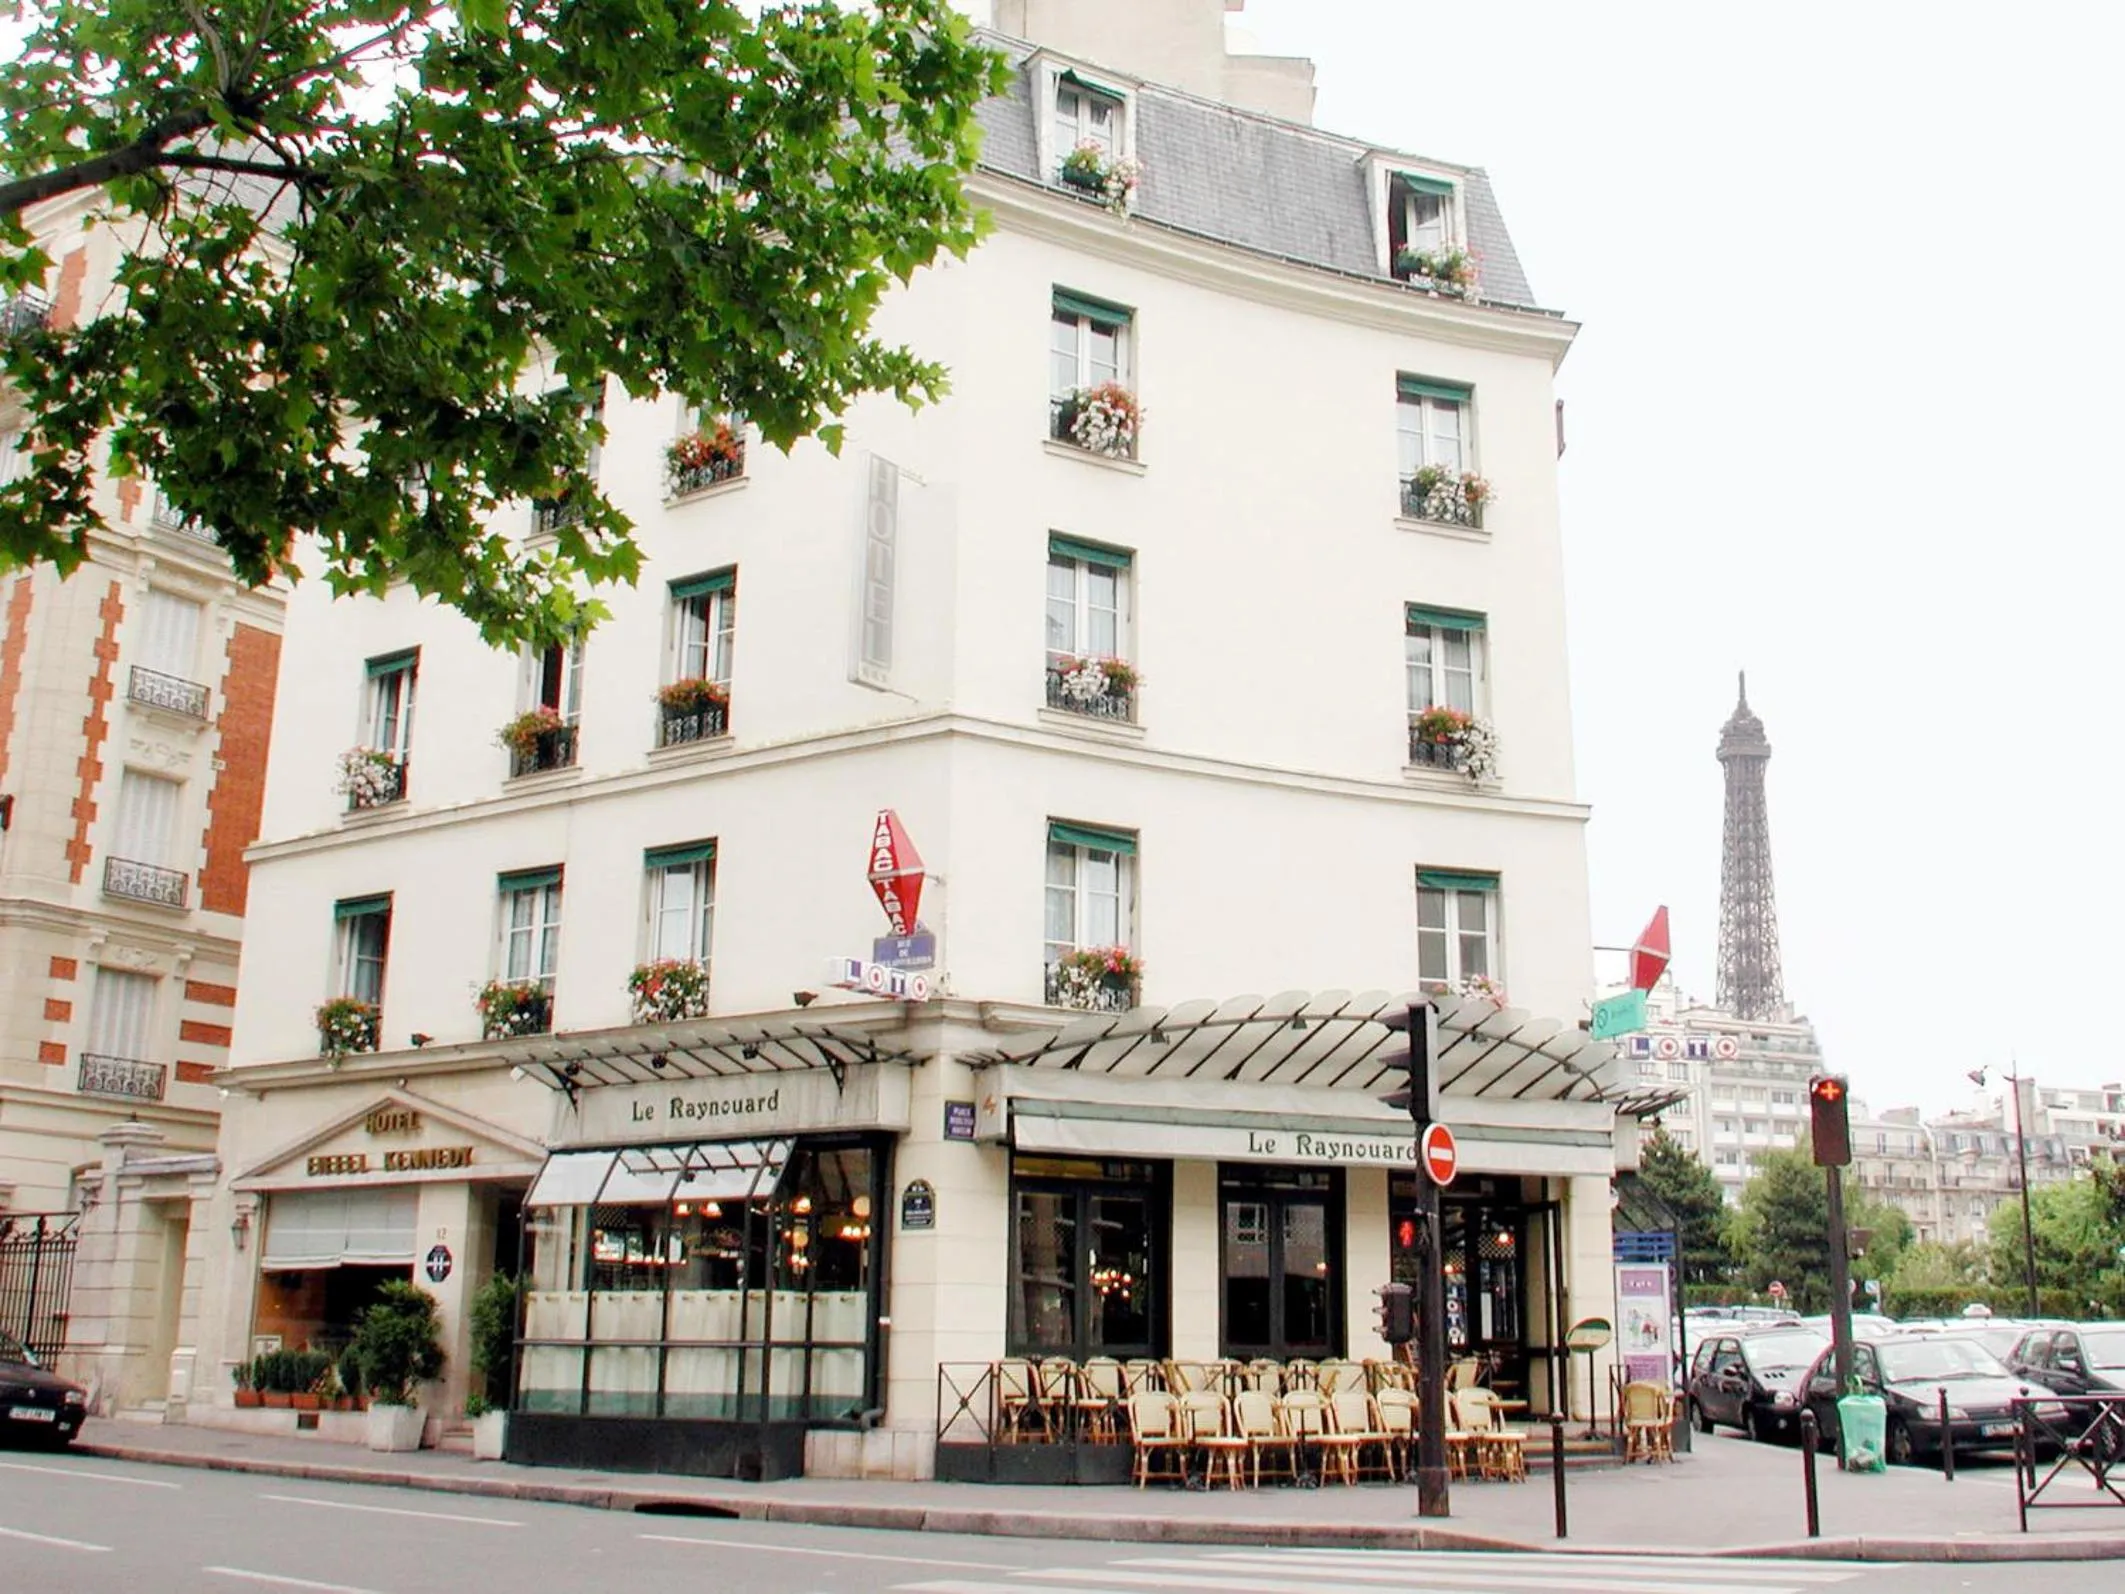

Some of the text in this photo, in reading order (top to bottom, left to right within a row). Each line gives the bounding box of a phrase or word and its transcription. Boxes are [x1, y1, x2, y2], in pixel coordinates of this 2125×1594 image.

[862, 457, 896, 668] HOTEL
[873, 812, 894, 872] TABAC
[876, 879, 906, 934] TABAC
[845, 958, 928, 1000] LOTO
[1631, 1038, 1736, 1058] LOTO
[366, 1110, 421, 1134] HOTEL
[632, 1089, 779, 1121] Le Raynouard
[384, 1147, 474, 1172] KENNEDY
[1248, 1132, 1276, 1154] Le
[1446, 1285, 1461, 1337] LOTO
